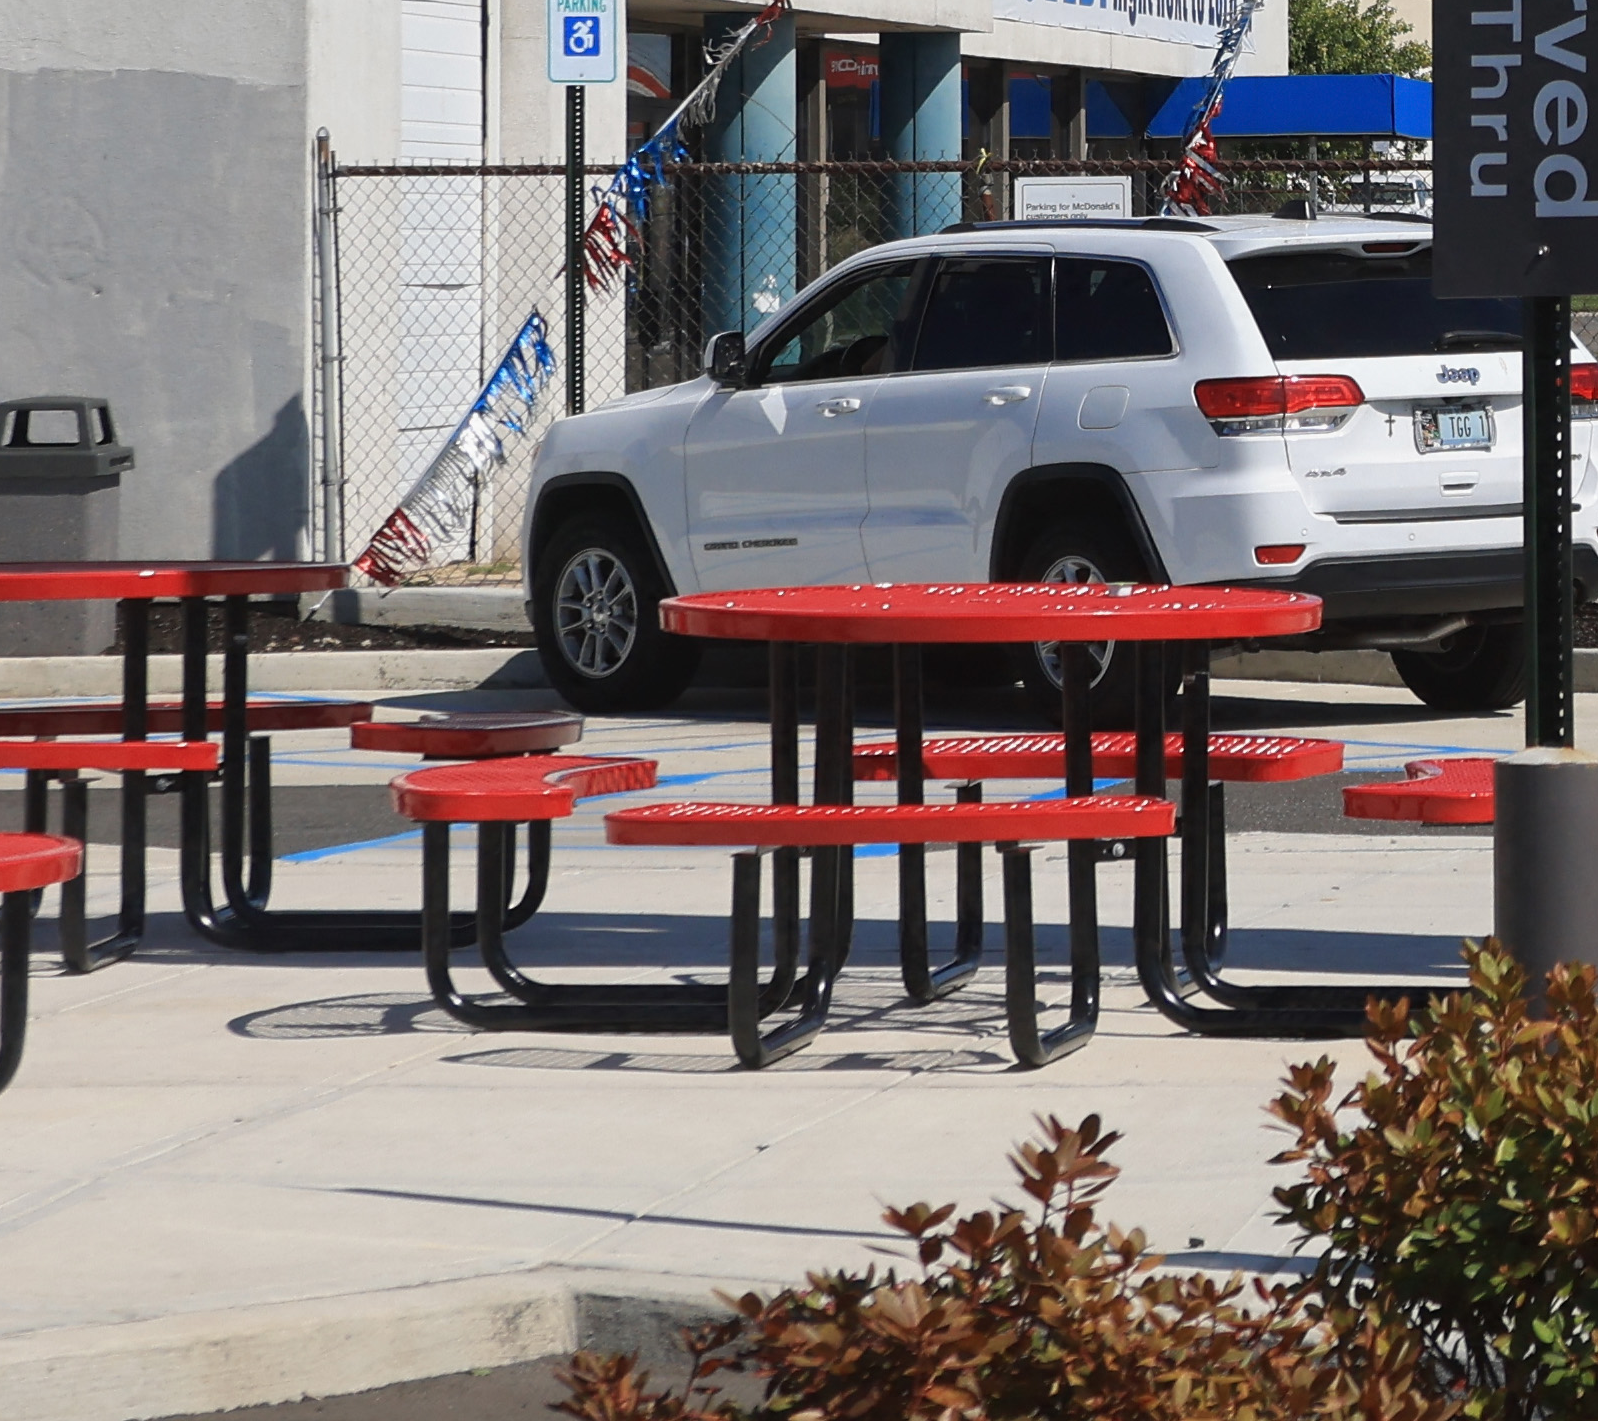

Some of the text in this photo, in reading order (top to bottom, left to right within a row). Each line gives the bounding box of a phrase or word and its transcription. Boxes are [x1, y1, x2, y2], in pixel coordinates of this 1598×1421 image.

[1026, 203, 1056, 212] Parking
[1072, 202, 1120, 210] McDonald's
[1436, 364, 1481, 386] Jeep
[1449, 416, 1472, 438] TGG
